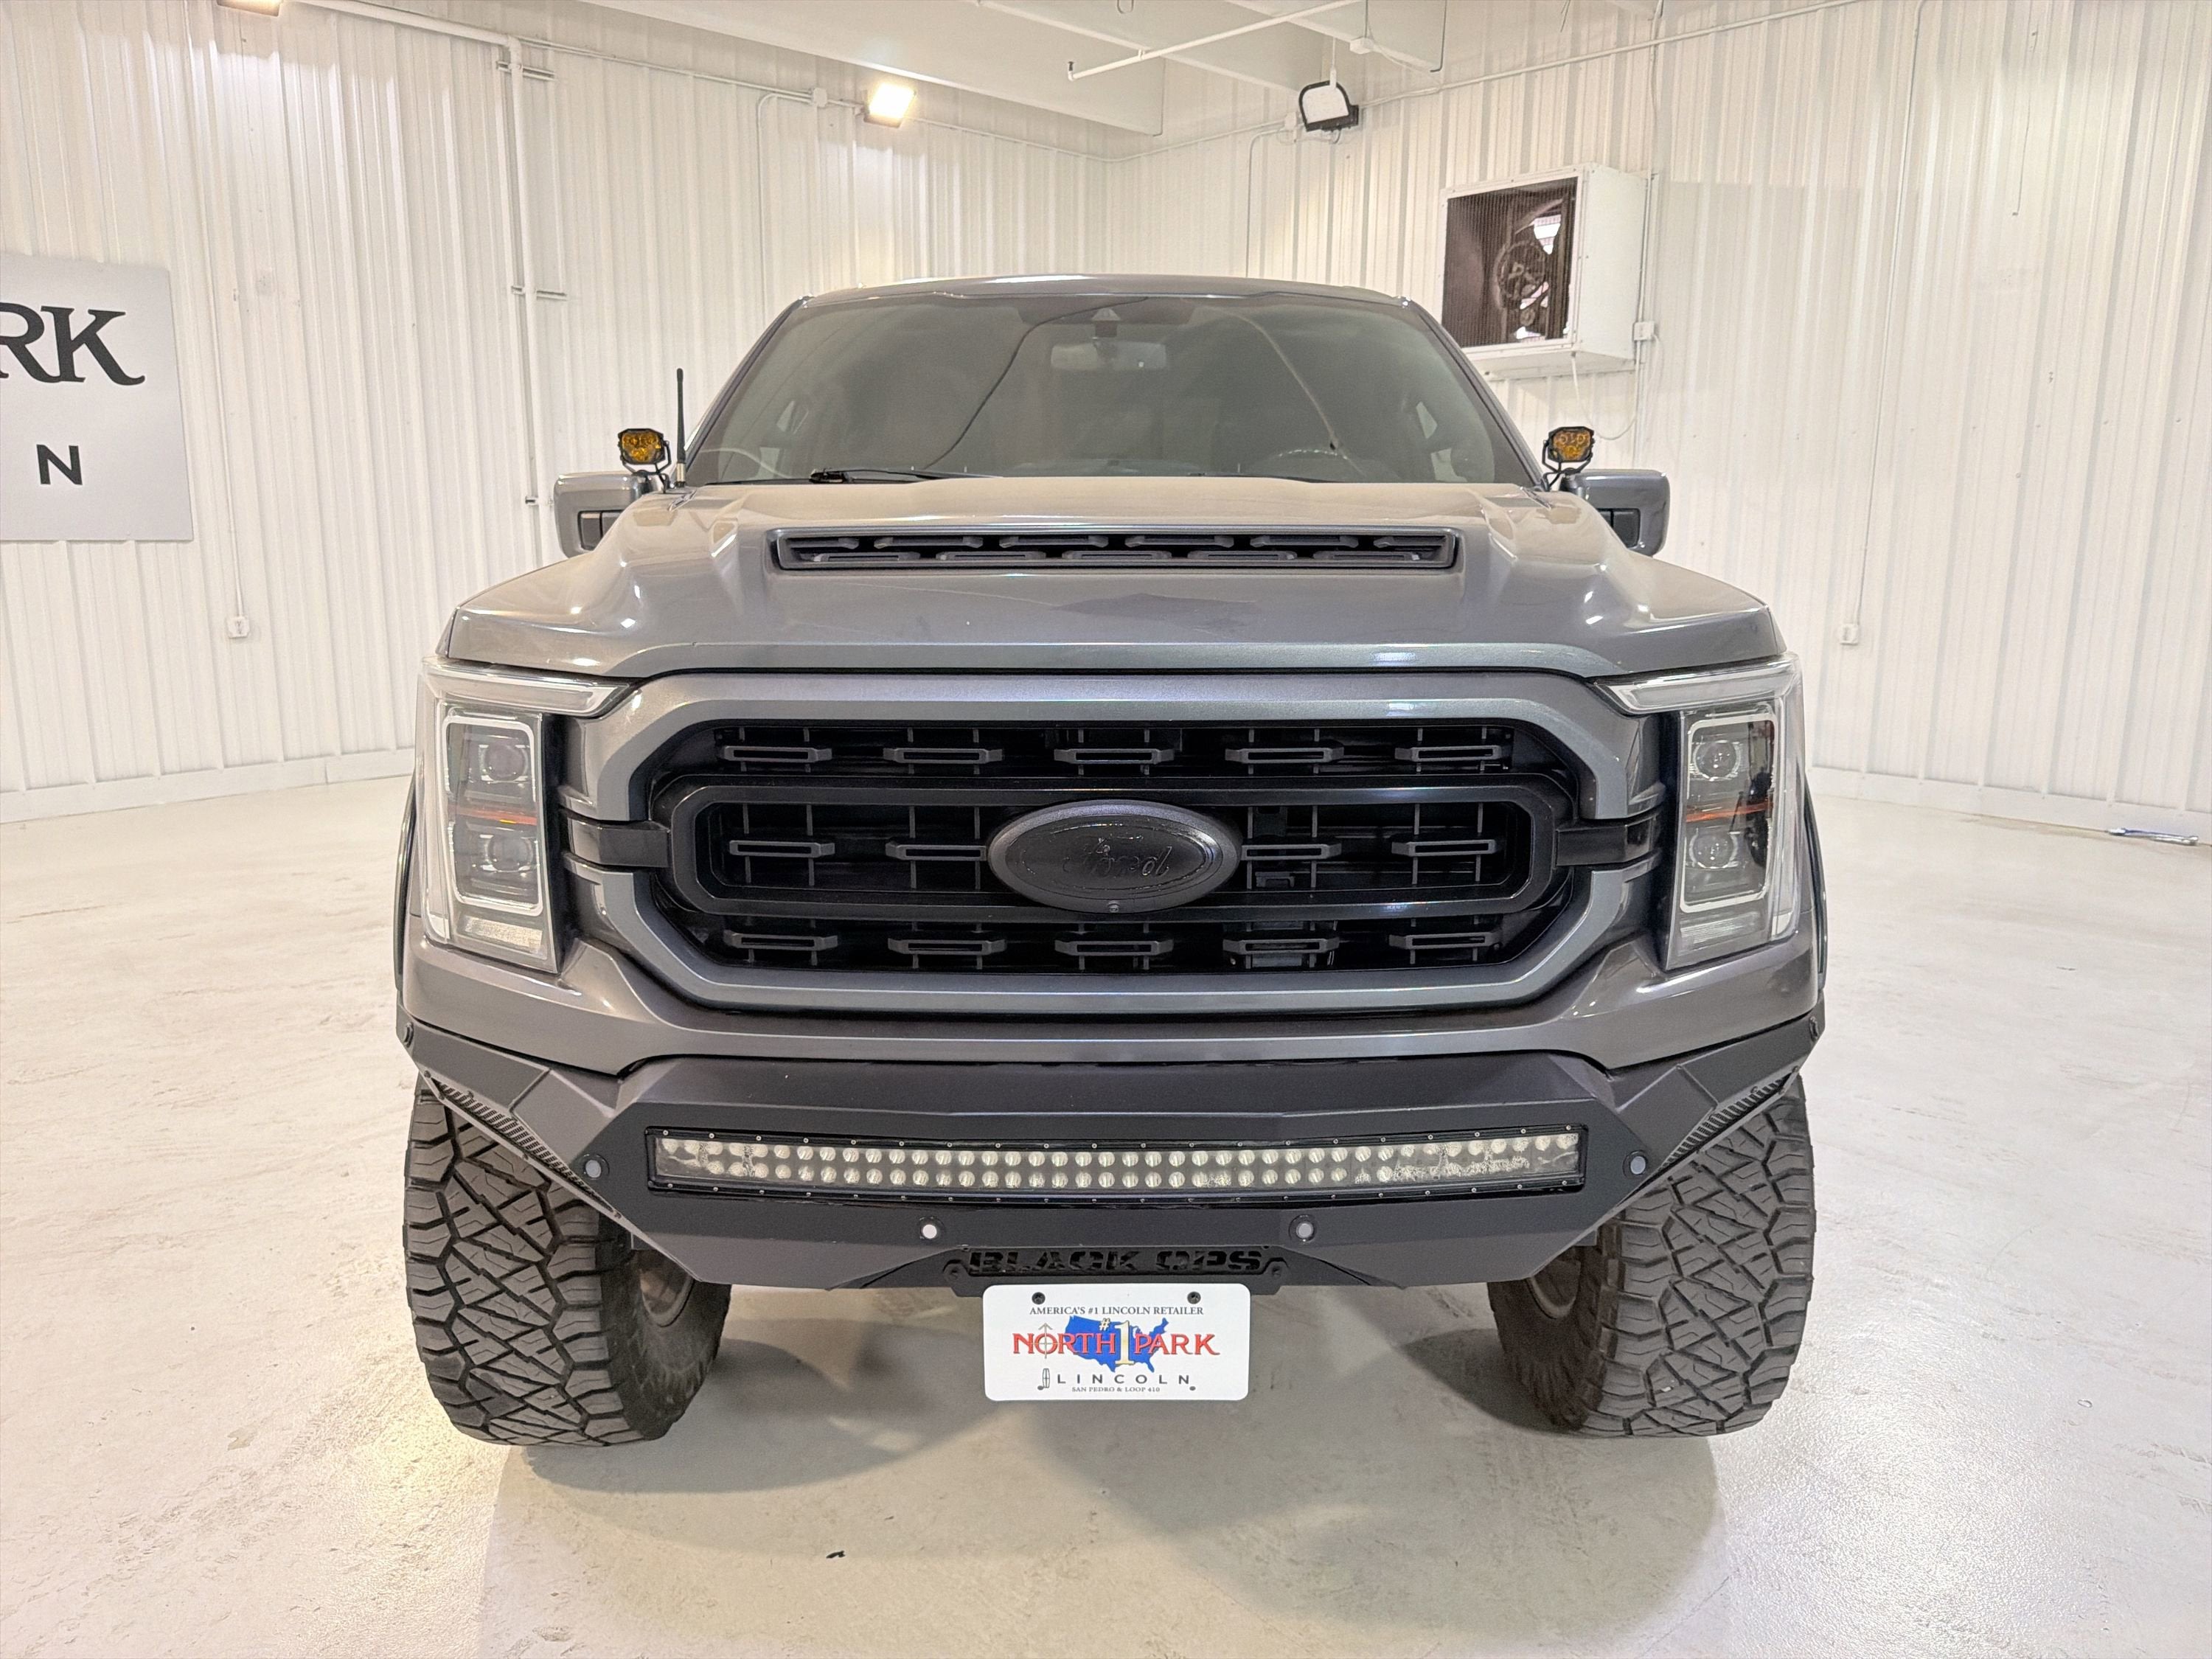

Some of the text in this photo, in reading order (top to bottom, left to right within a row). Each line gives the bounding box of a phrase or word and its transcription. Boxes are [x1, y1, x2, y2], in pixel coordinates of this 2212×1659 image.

[969, 1251, 1262, 1272] BLACK OPS
[1029, 1307, 1203, 1315] AMERICA'S #1 LINCOLN RETAILER
[1012, 1333, 1220, 1355] NORTH PARK
[1057, 1374, 1189, 1385] LINCOLN
